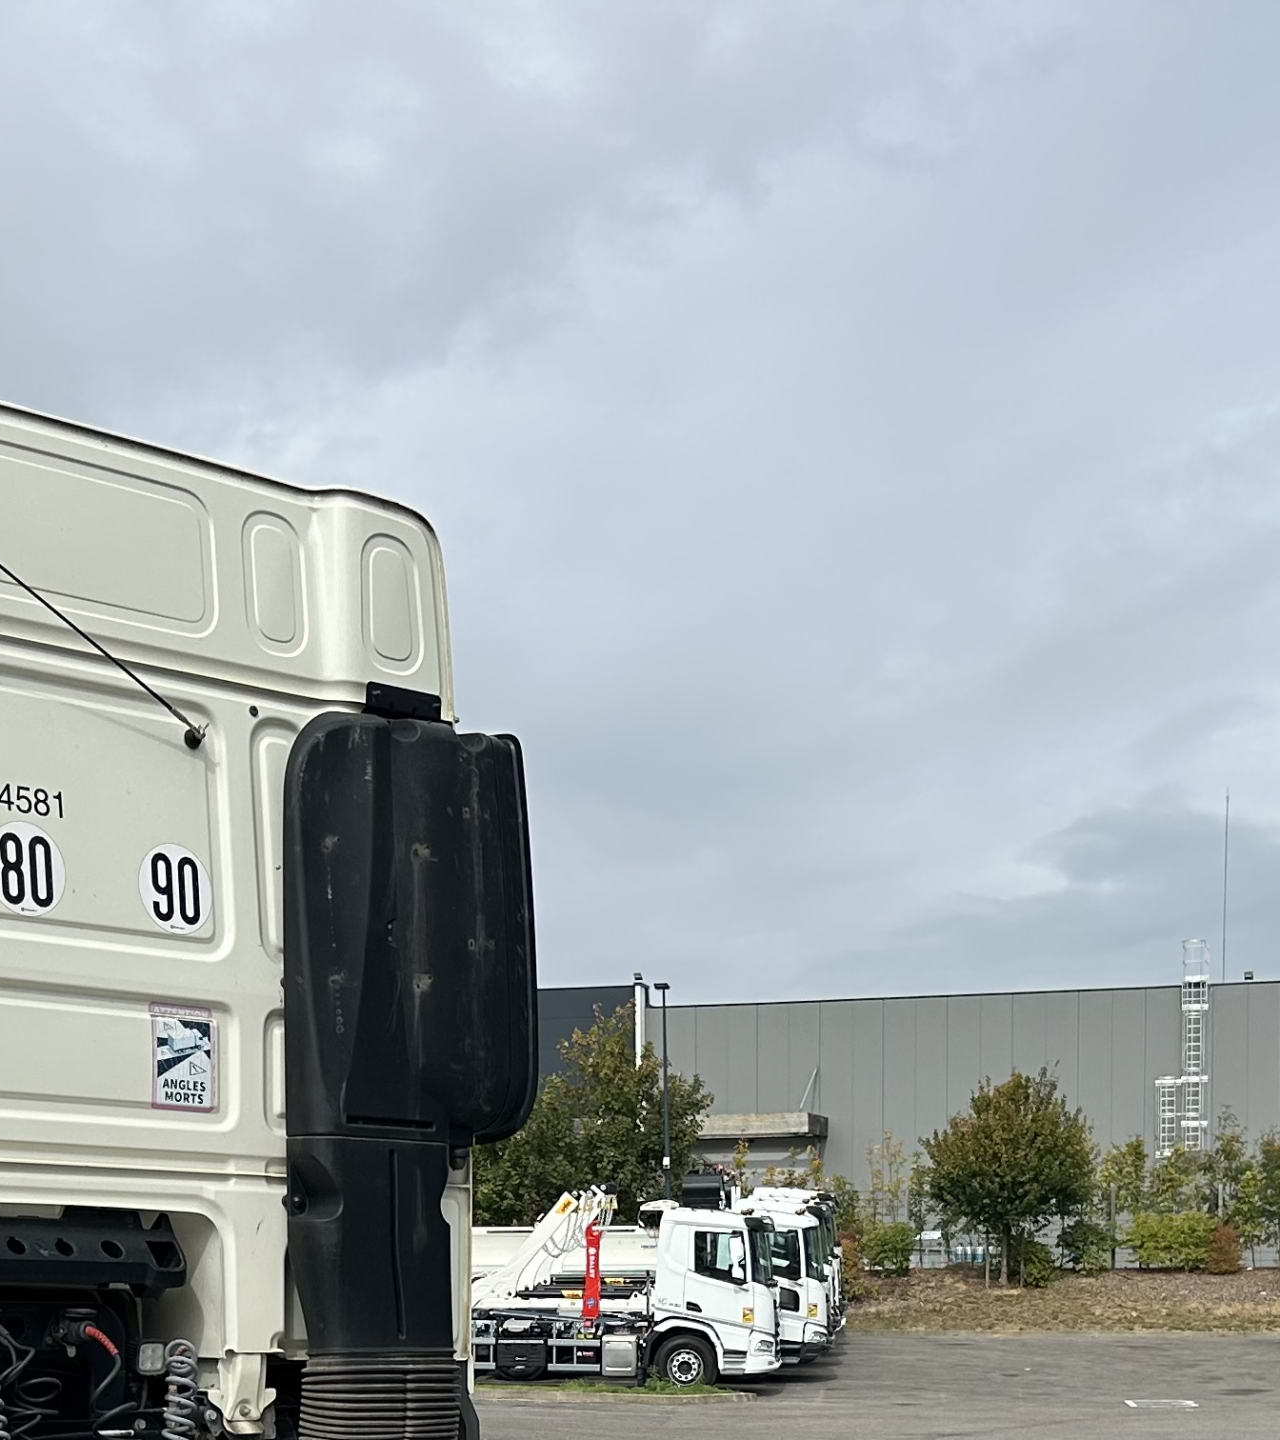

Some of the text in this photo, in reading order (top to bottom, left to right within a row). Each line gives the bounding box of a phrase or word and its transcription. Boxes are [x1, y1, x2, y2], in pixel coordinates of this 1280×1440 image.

[0, 832, 54, 907] 80
[150, 852, 201, 925] 90
[162, 1078, 207, 1092] ANGLES
[164, 1091, 204, 1105] MORTS
